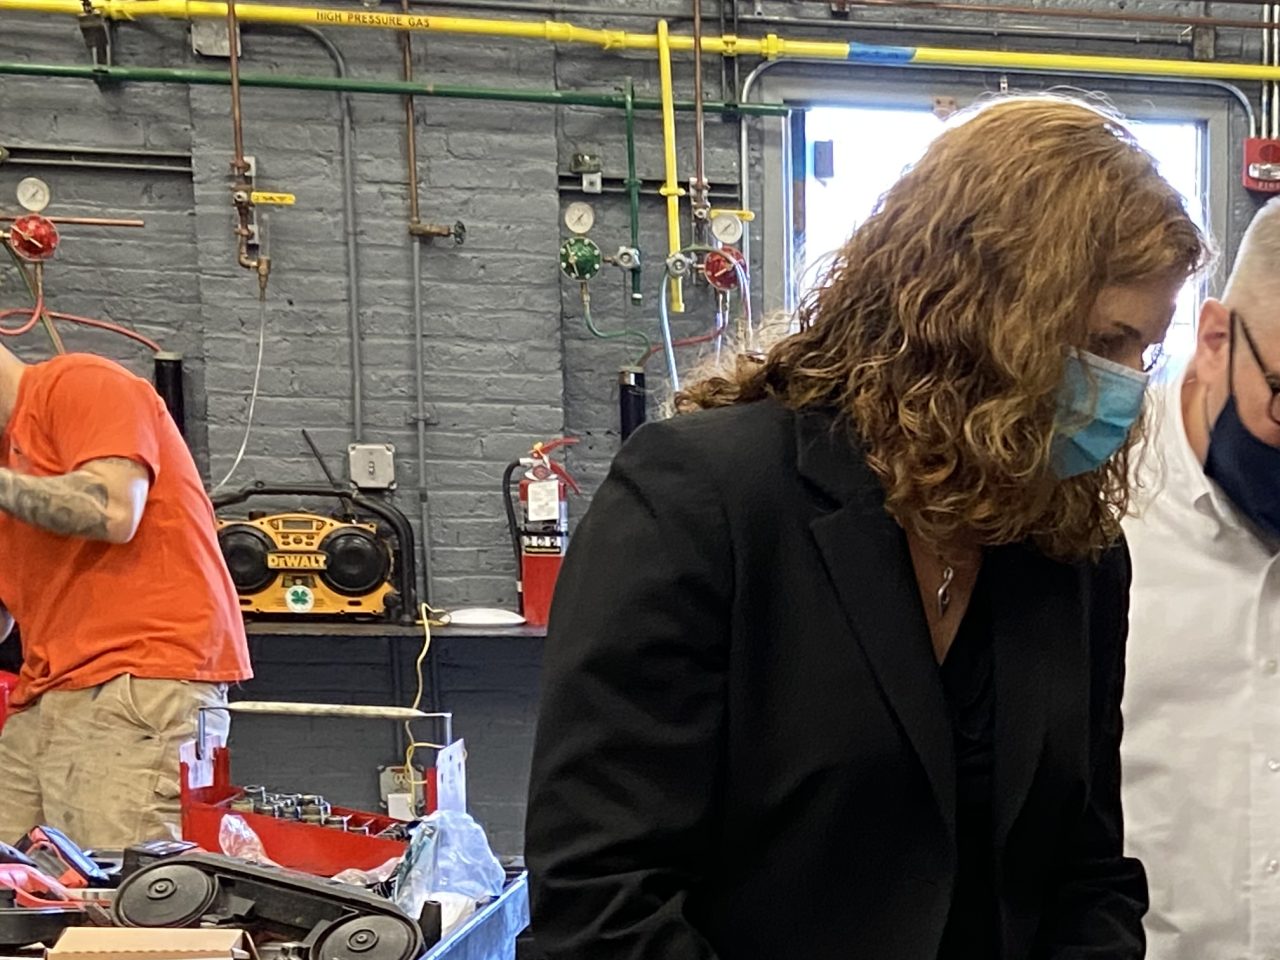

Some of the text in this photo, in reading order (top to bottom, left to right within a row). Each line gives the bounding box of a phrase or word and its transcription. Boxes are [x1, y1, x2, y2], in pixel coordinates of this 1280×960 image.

[316, 11, 430, 28] HIGH PRESSURE GAS
